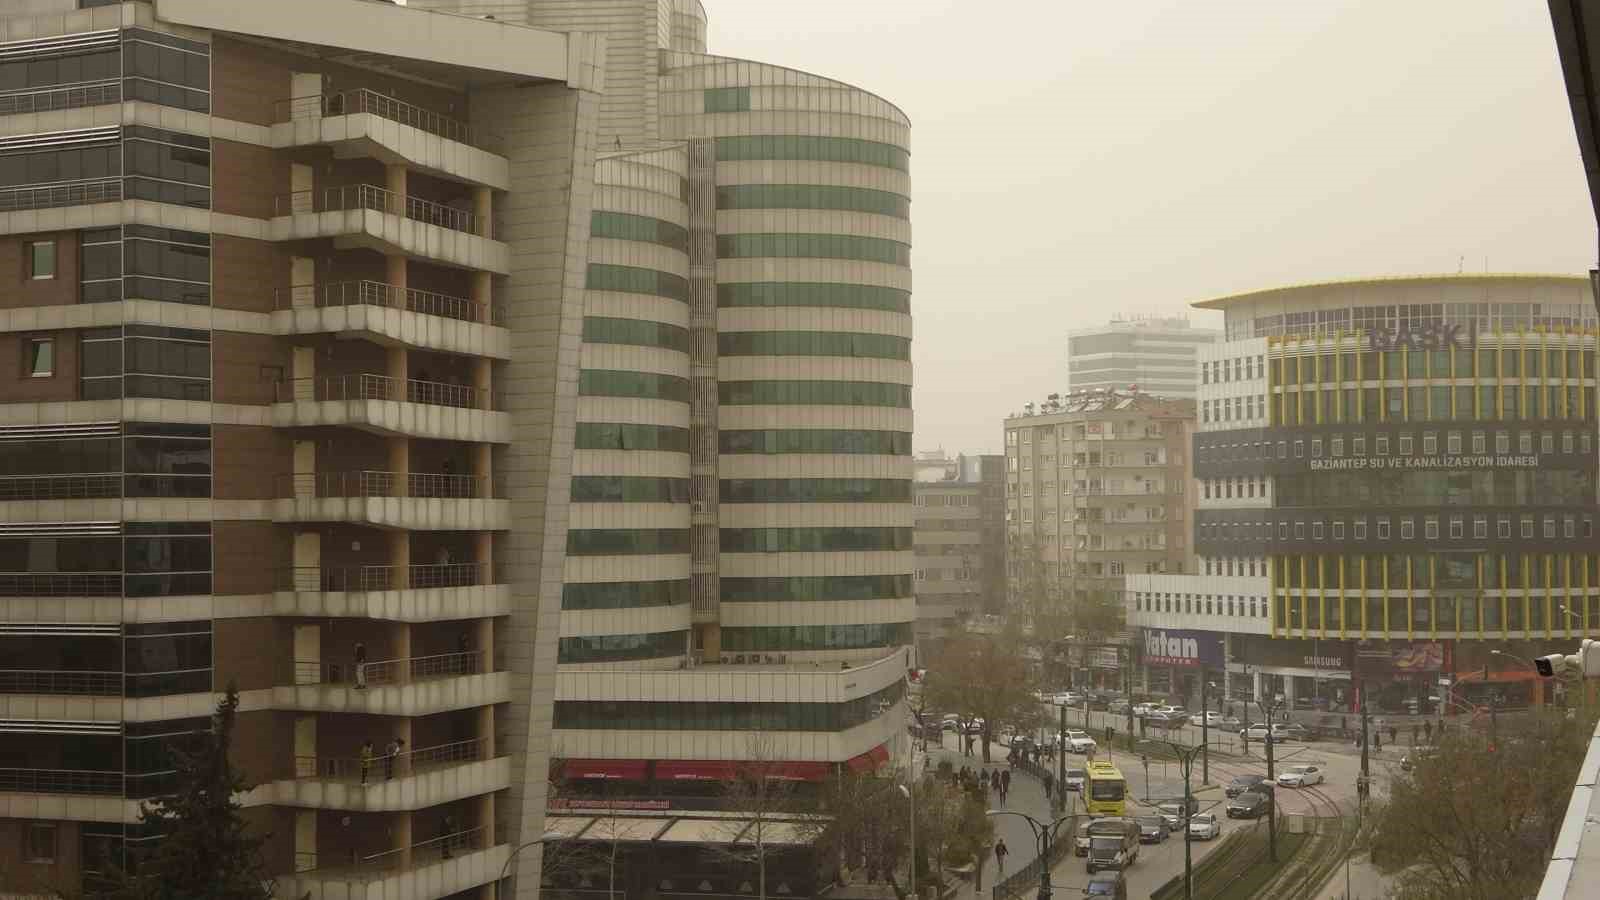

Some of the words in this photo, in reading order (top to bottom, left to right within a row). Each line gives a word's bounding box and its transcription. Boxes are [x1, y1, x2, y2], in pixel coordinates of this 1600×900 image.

[1310, 456, 1367, 470] GAZİANTEP
[1369, 458, 1385, 469] SU
[1388, 457, 1402, 468] VE
[1405, 453, 1494, 468] KANALİZASYON
[1144, 629, 1198, 658] Vatan
[1304, 655, 1344, 666] SAMSUNG
